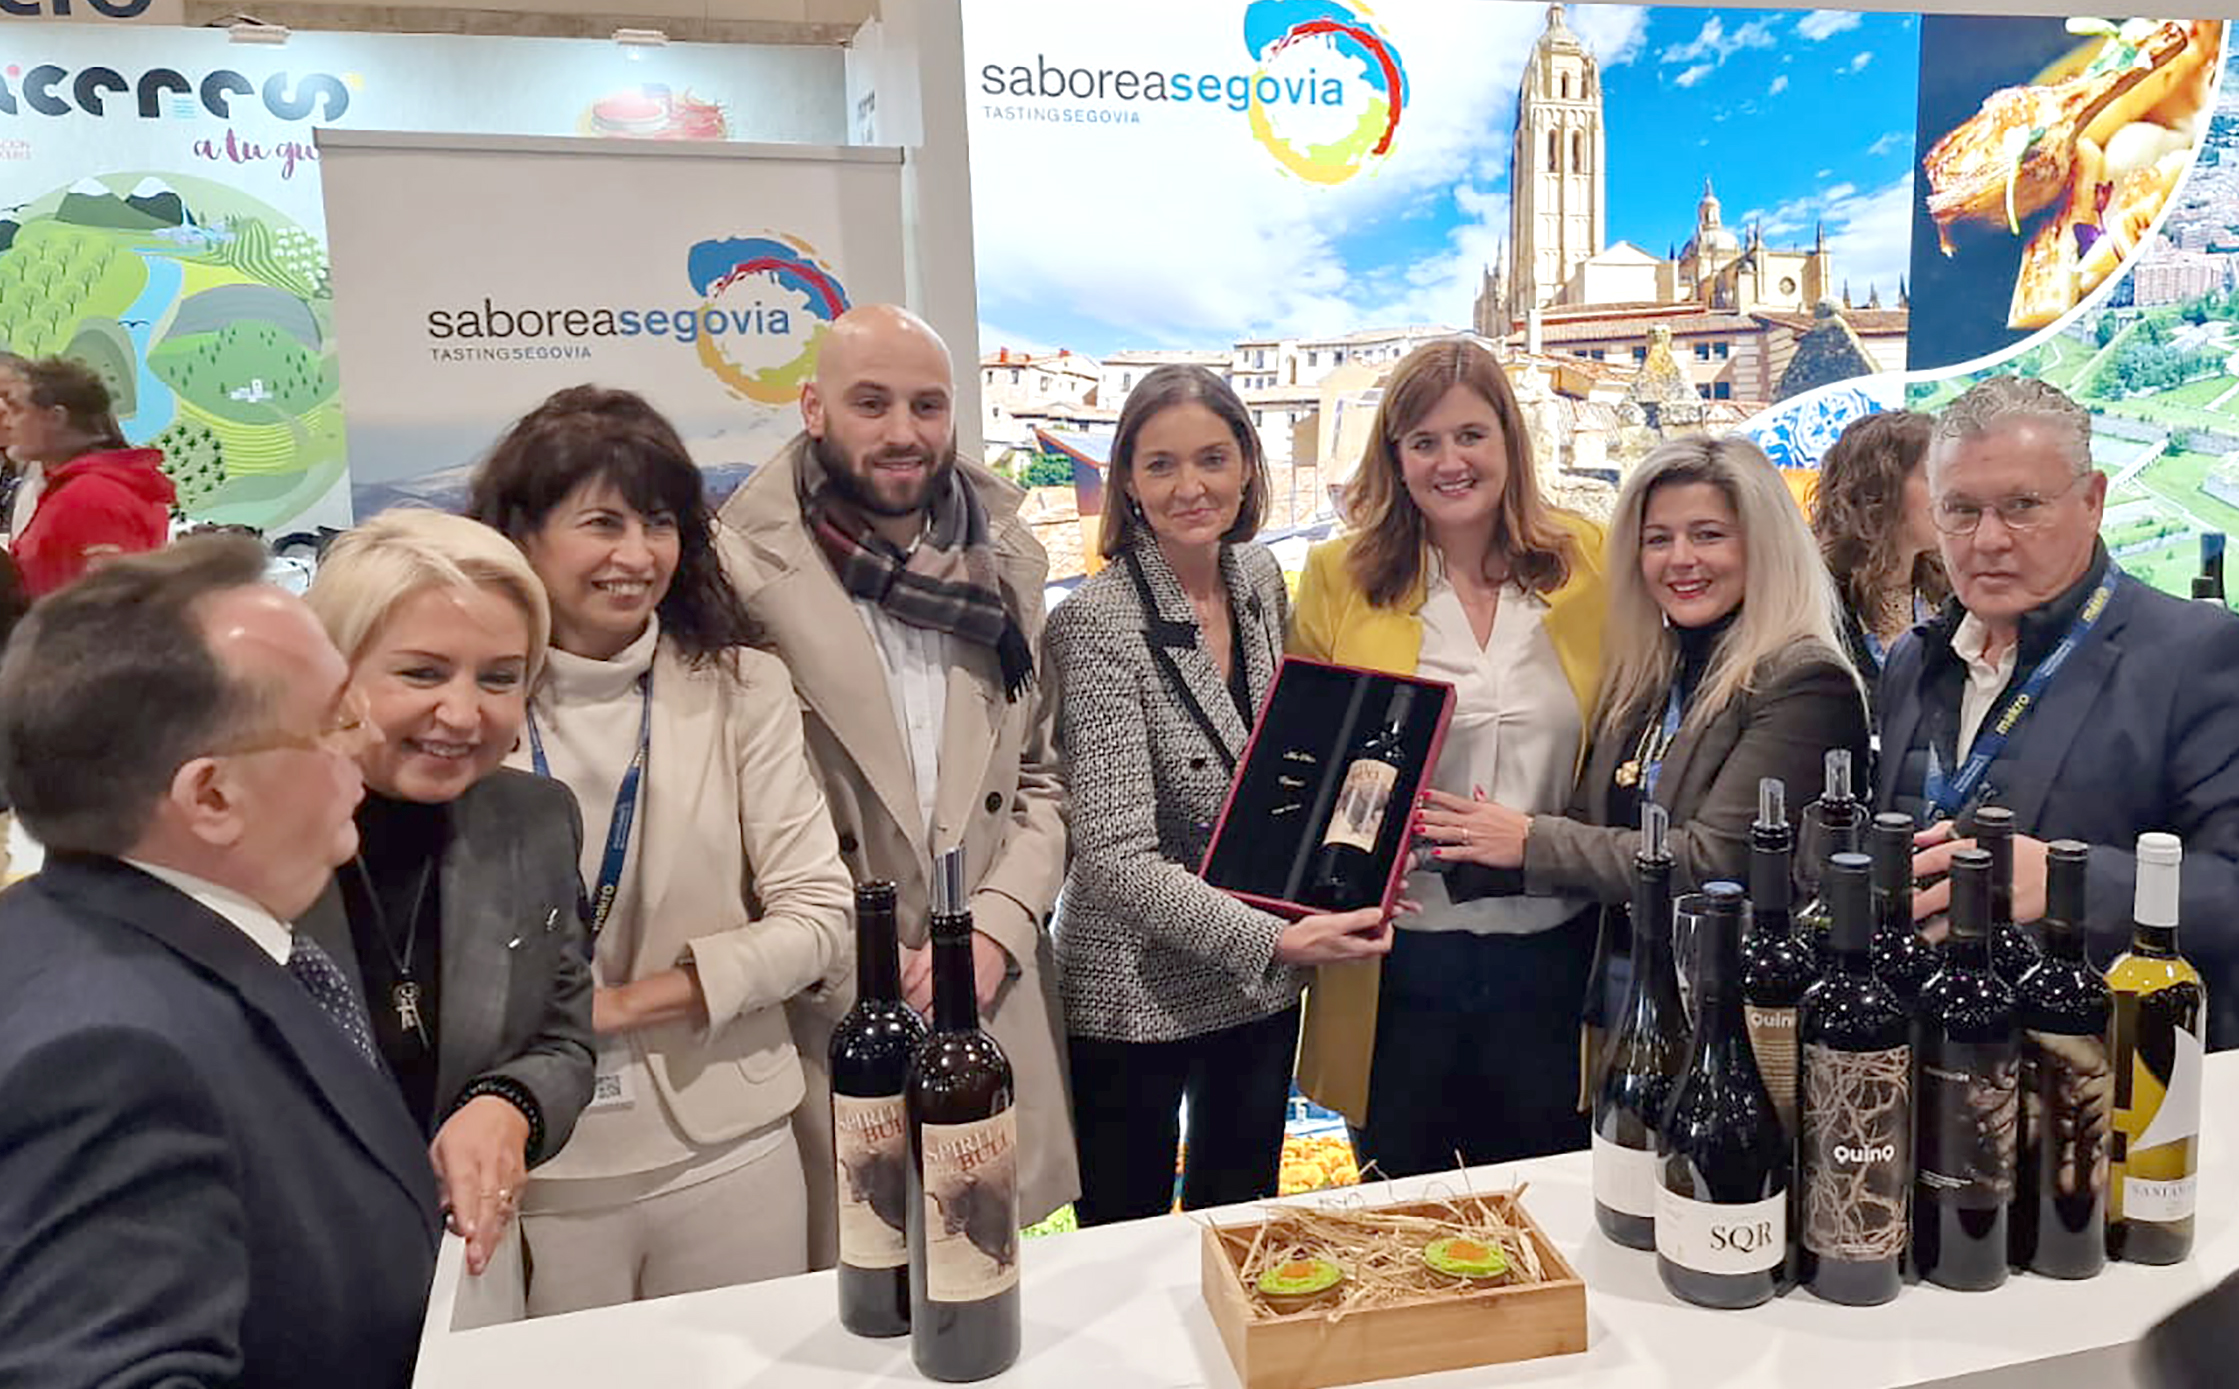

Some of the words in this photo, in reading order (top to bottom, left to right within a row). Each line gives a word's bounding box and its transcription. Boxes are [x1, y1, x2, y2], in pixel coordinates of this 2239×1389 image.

[193, 139, 222, 161] a
[225, 126, 271, 165] tu
[275, 140, 321, 180] gu
[1995, 693, 2031, 735] makro
[1711, 1220, 1773, 1254] SQR
